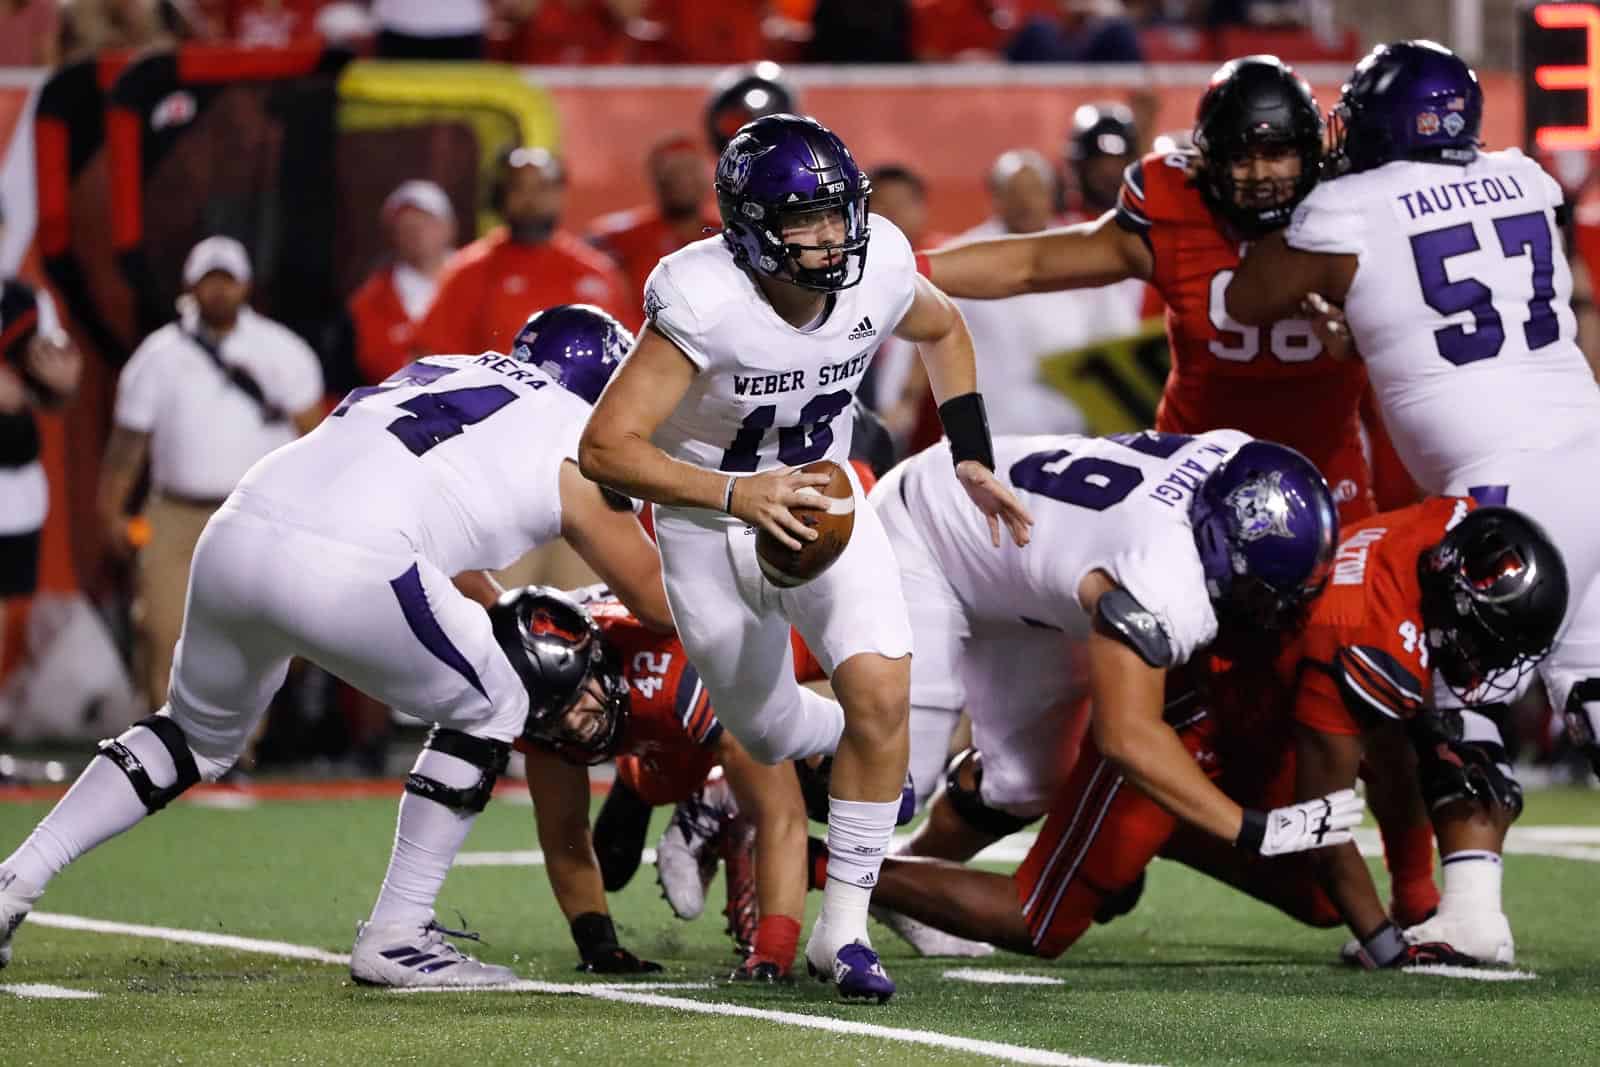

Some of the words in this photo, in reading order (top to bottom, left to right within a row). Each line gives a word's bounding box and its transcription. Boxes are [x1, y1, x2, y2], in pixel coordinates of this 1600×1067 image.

[1535, 3, 1600, 150] 3
[1398, 175, 1524, 220] TAUTEOLI
[1408, 210, 1561, 367] 57
[734, 370, 805, 396] WEBER
[633, 651, 672, 699] 42
